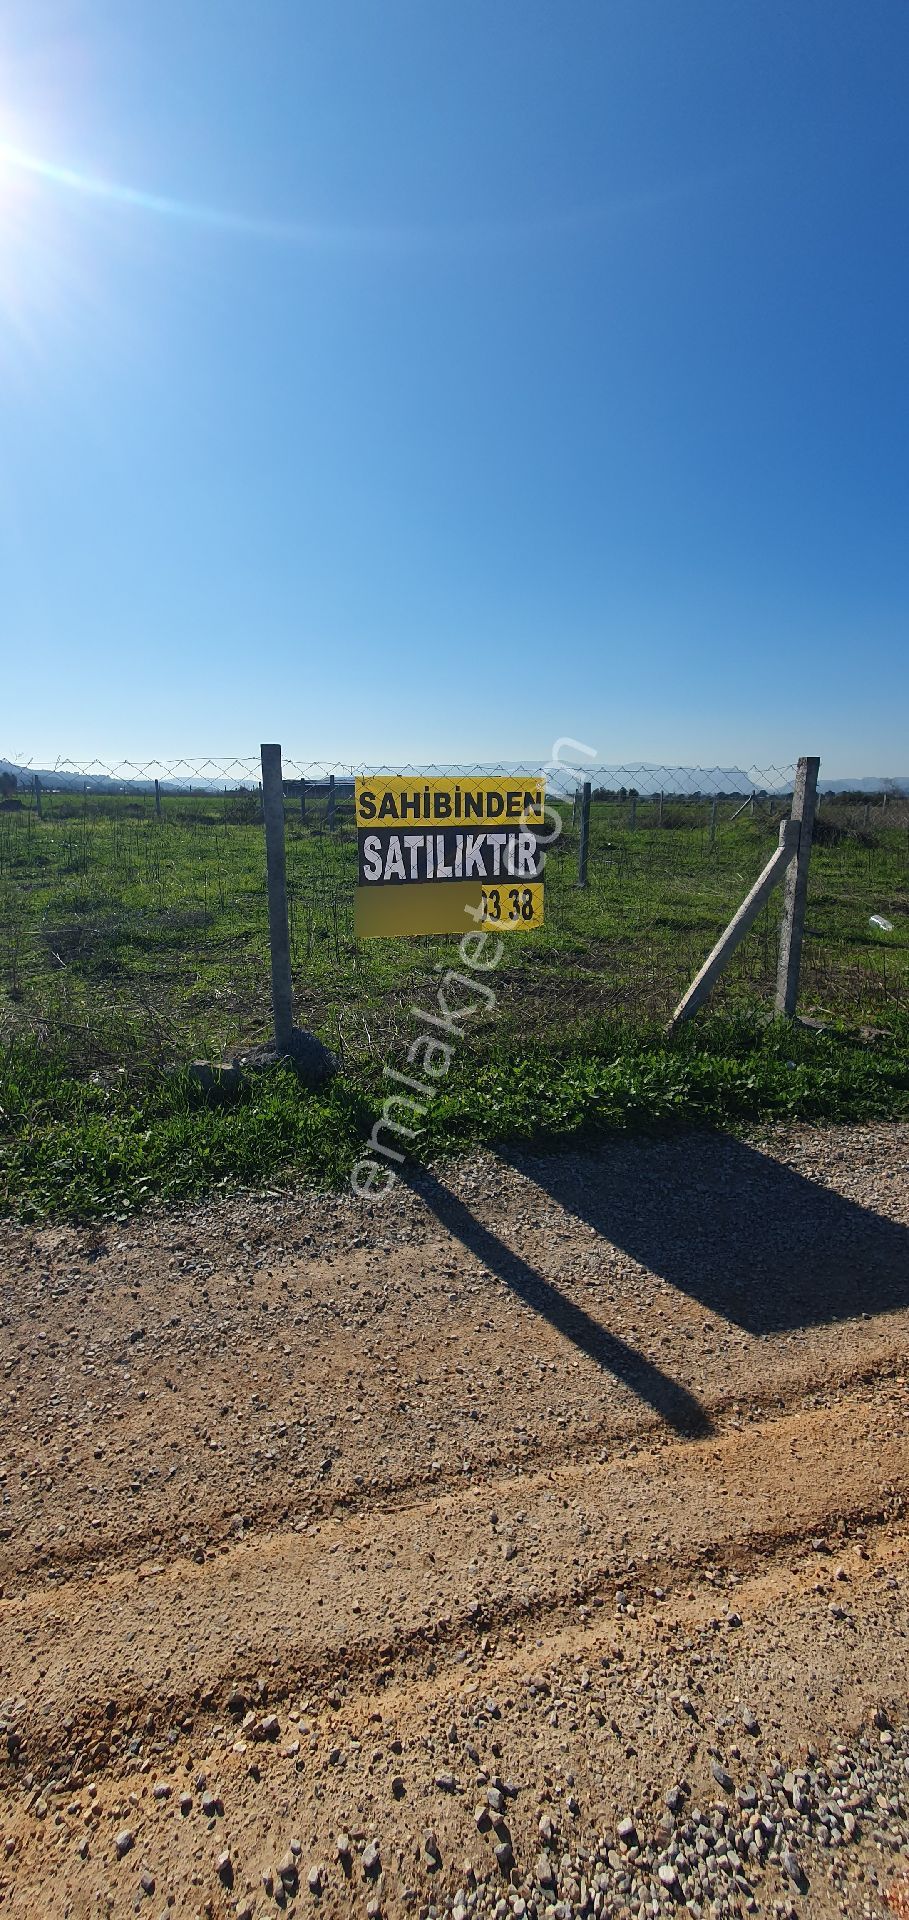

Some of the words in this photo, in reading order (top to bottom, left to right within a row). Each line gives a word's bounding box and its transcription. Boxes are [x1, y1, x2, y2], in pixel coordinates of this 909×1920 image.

[359, 785, 541, 820] SAHİBİNDEN
[363, 833, 537, 881] SATILIKTIR
[508, 888, 534, 921] 38
